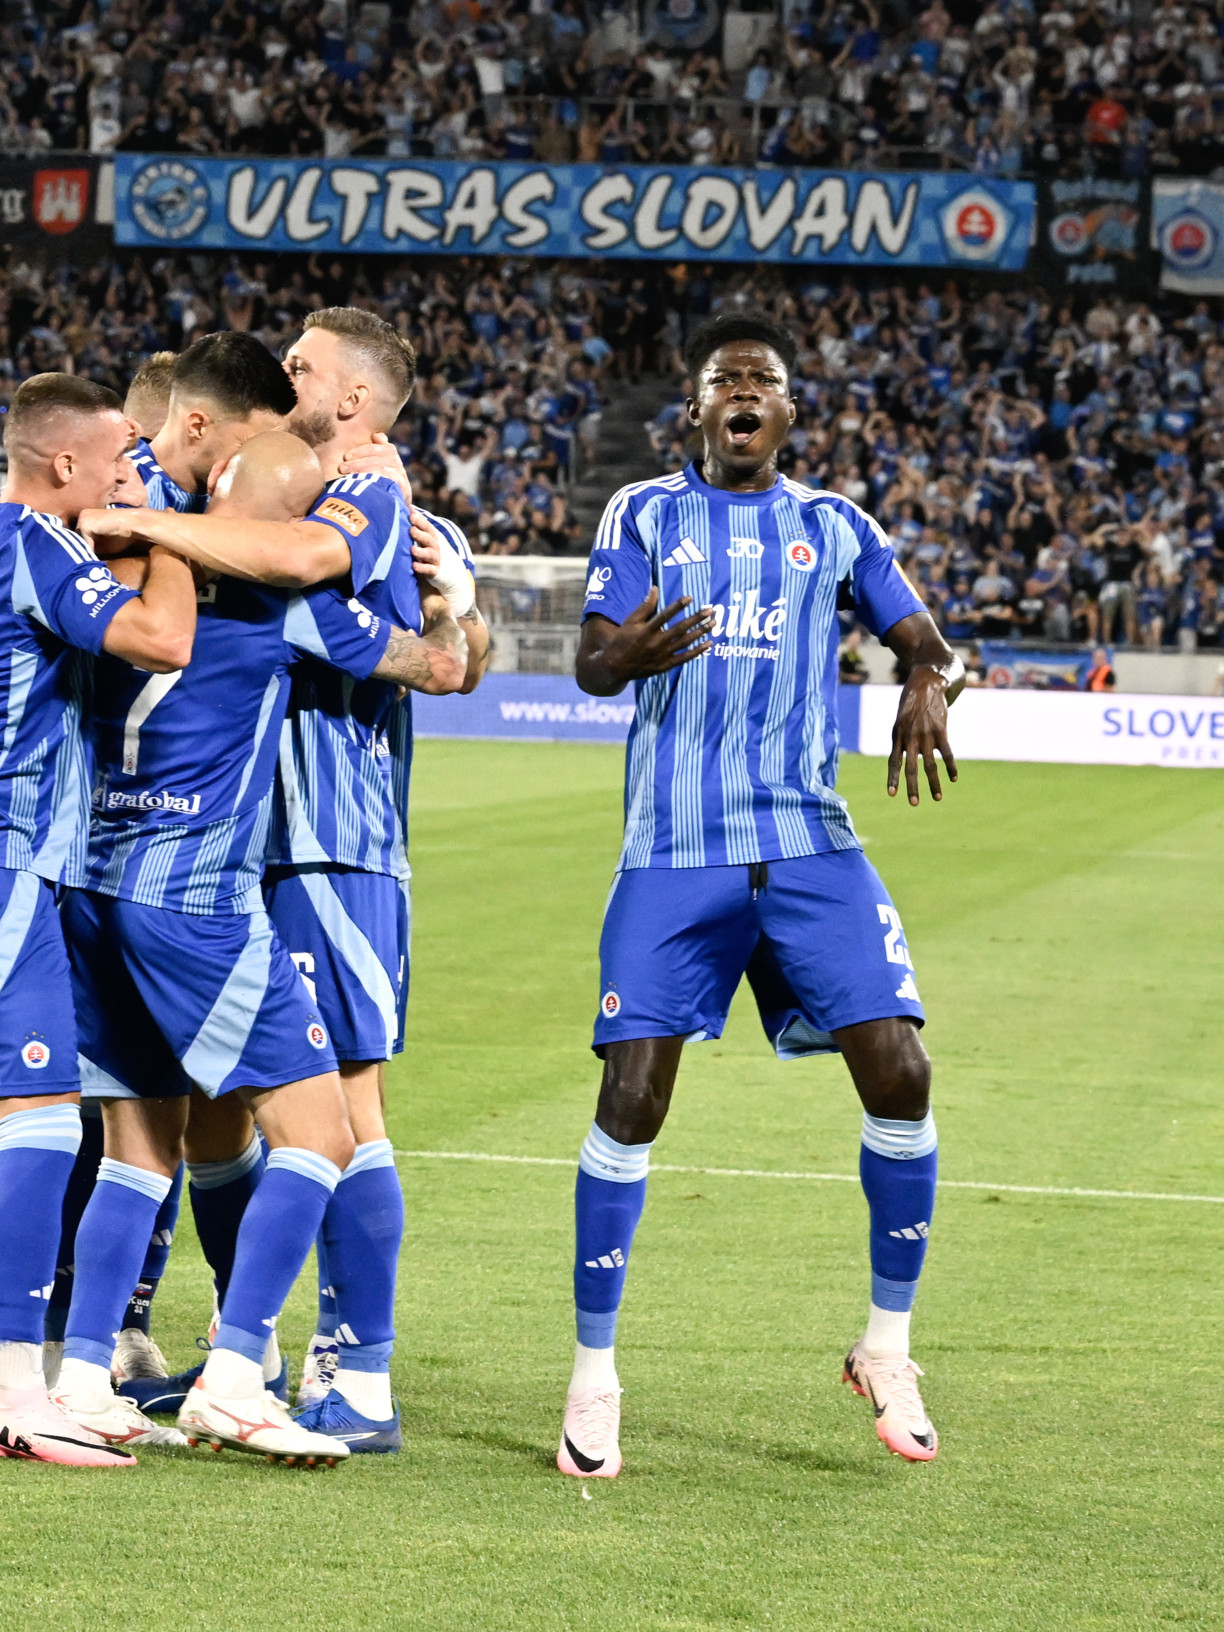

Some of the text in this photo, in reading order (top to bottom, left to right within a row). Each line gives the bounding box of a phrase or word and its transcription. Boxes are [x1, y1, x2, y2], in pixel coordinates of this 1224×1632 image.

[227, 165, 556, 250] ULTRAS
[580, 172, 919, 256] SLOVAN
[701, 589, 787, 641] niké
[715, 642, 780, 660] tipovanie
[107, 791, 201, 814] grafobal
